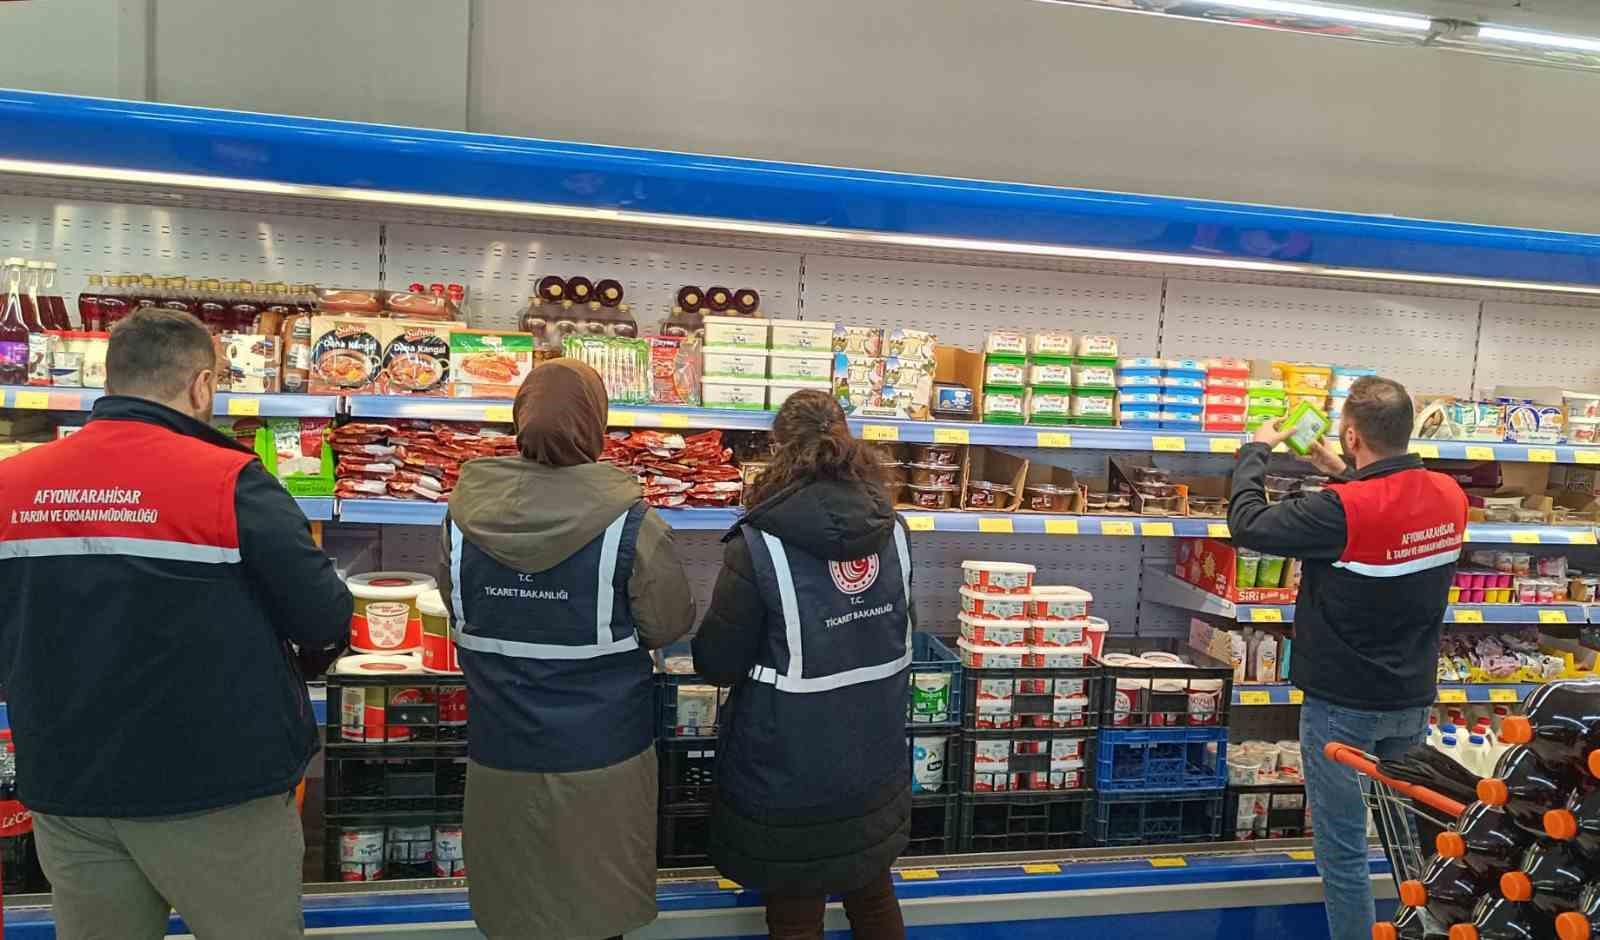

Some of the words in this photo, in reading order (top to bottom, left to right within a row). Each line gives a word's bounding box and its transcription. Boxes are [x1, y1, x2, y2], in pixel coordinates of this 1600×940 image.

[33, 486, 142, 504] AFYONKARAHİSAR
[10, 509, 18, 524] İL
[19, 510, 49, 522] TARIM
[50, 509, 63, 522] VE
[64, 510, 98, 522] ORMAN
[99, 508, 159, 524] MÜDÜRLÜĞÜ
[518, 573, 534, 582] T.C.
[484, 586, 518, 598] TİCARET
[519, 588, 569, 600] BAKANLIĞI
[824, 612, 854, 628] TİCARET
